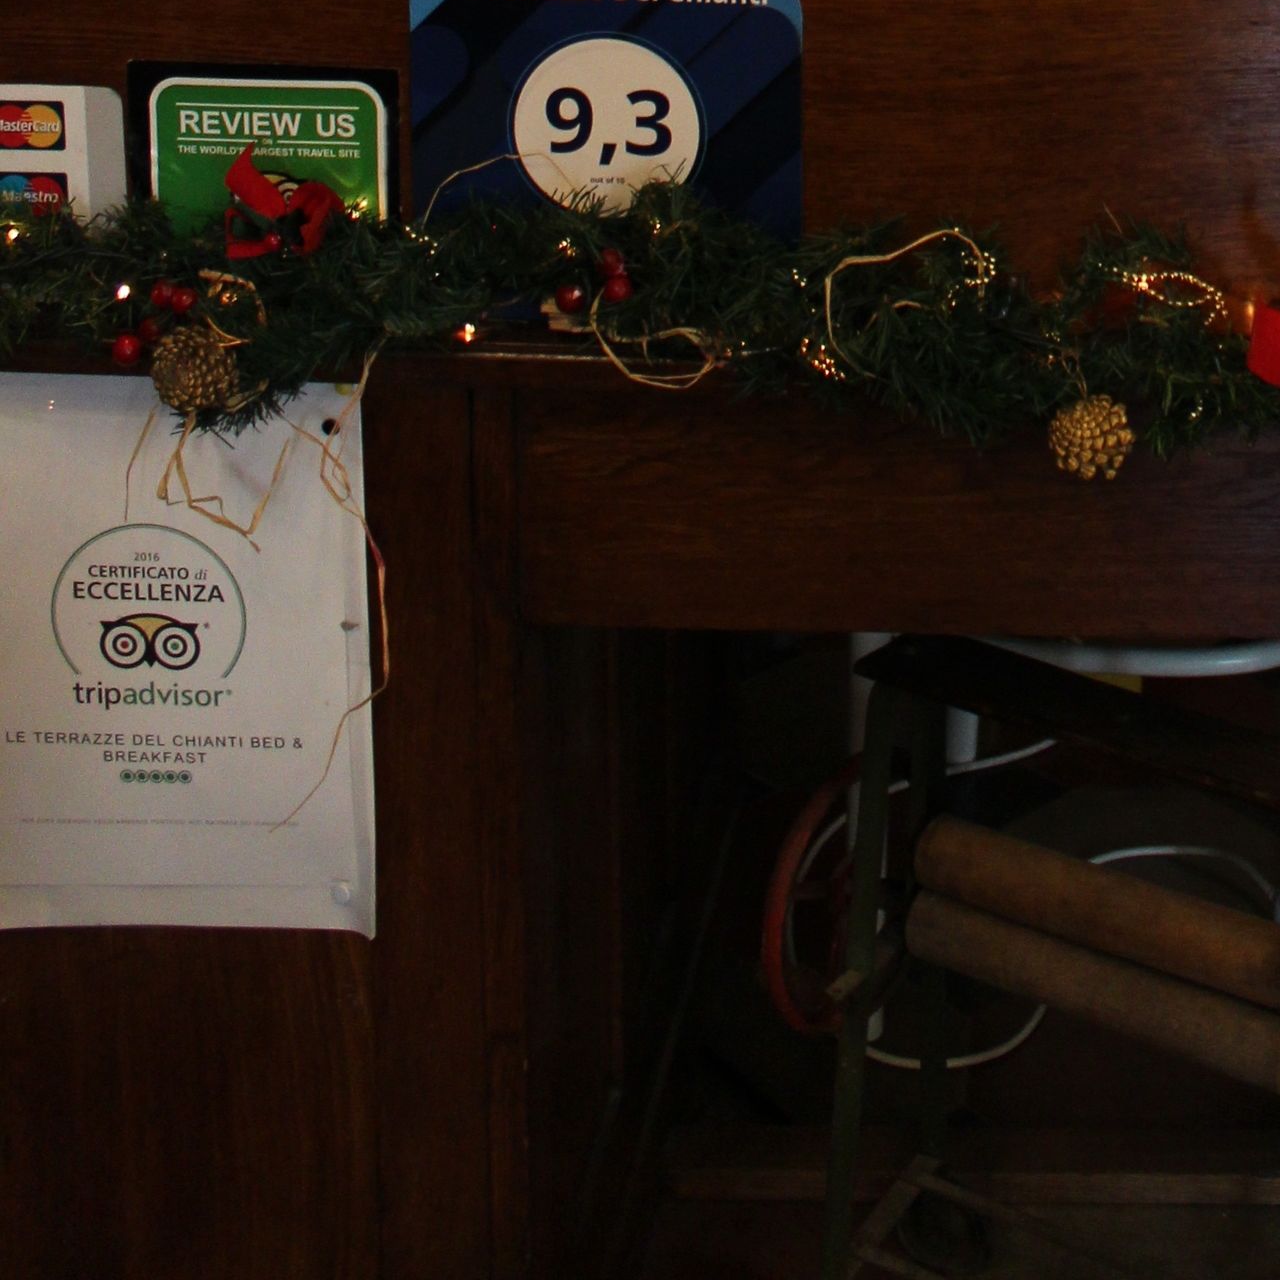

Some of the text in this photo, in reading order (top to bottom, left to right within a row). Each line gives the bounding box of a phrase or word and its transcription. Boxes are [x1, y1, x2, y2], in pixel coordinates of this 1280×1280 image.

[180, 110, 356, 137] REVIEW US
[545, 87, 672, 166] 9,3
[177, 145, 197, 154] THE
[297, 148, 335, 158] TRAVEL
[339, 149, 361, 159] SITE
[590, 176, 604, 184] out
[606, 176, 615, 184] of
[134, 552, 160, 561] 2016
[88, 565, 208, 580] CERTIFICATO di
[72, 582, 225, 602] ECCELLENZA
[73, 681, 223, 710] tripadvisor
[6, 732, 302, 749] LE TERRAZZE DEL CHIANTI BED &
[103, 751, 207, 764] BREAKFAST
